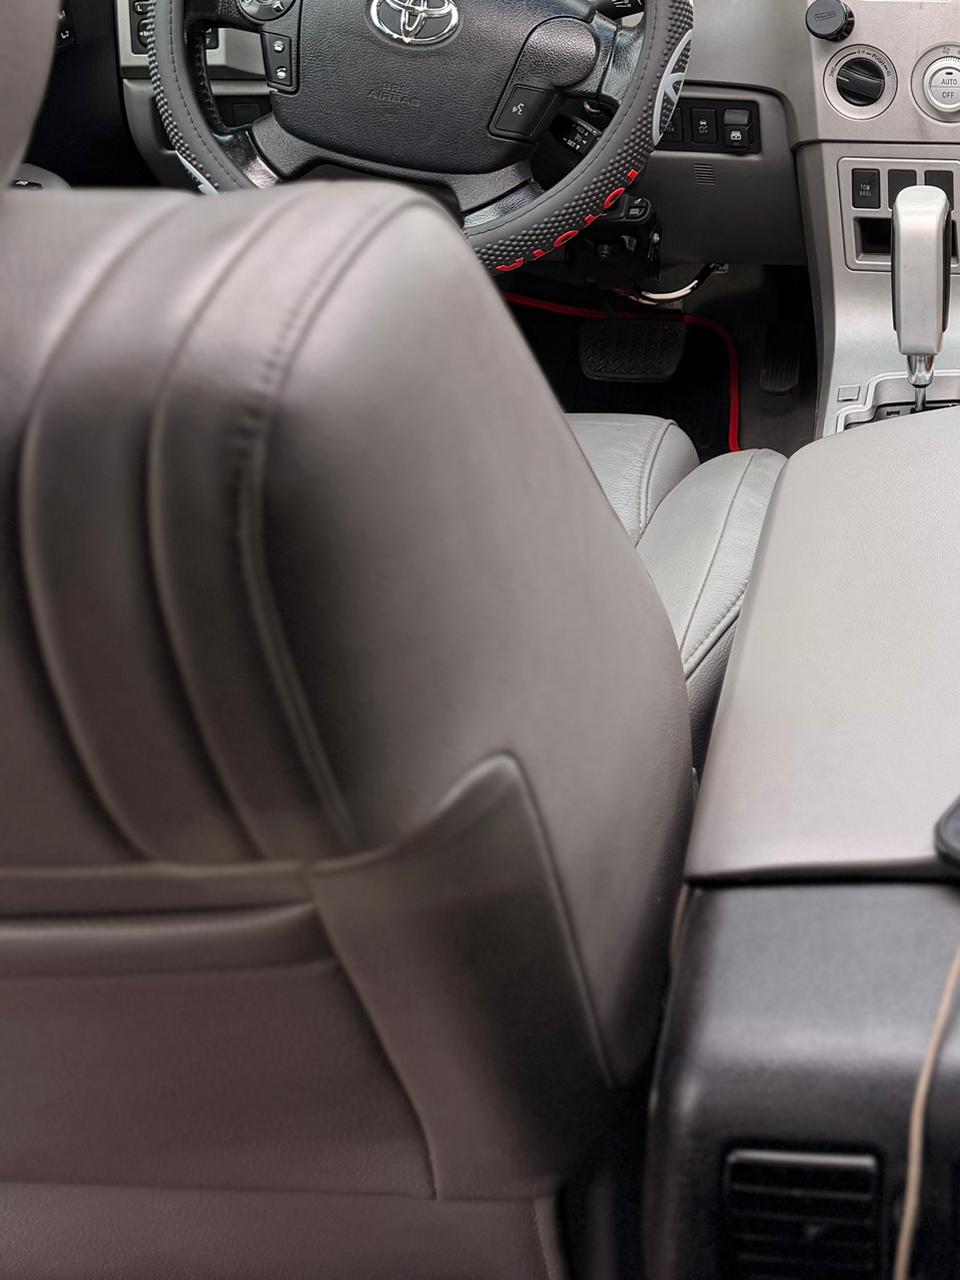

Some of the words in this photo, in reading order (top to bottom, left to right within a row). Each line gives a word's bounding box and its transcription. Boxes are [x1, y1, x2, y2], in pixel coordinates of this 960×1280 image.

[871, 53, 885, 66] PUSH
[367, 89, 421, 107] AIRBAG
[941, 91, 955, 99] OFF
